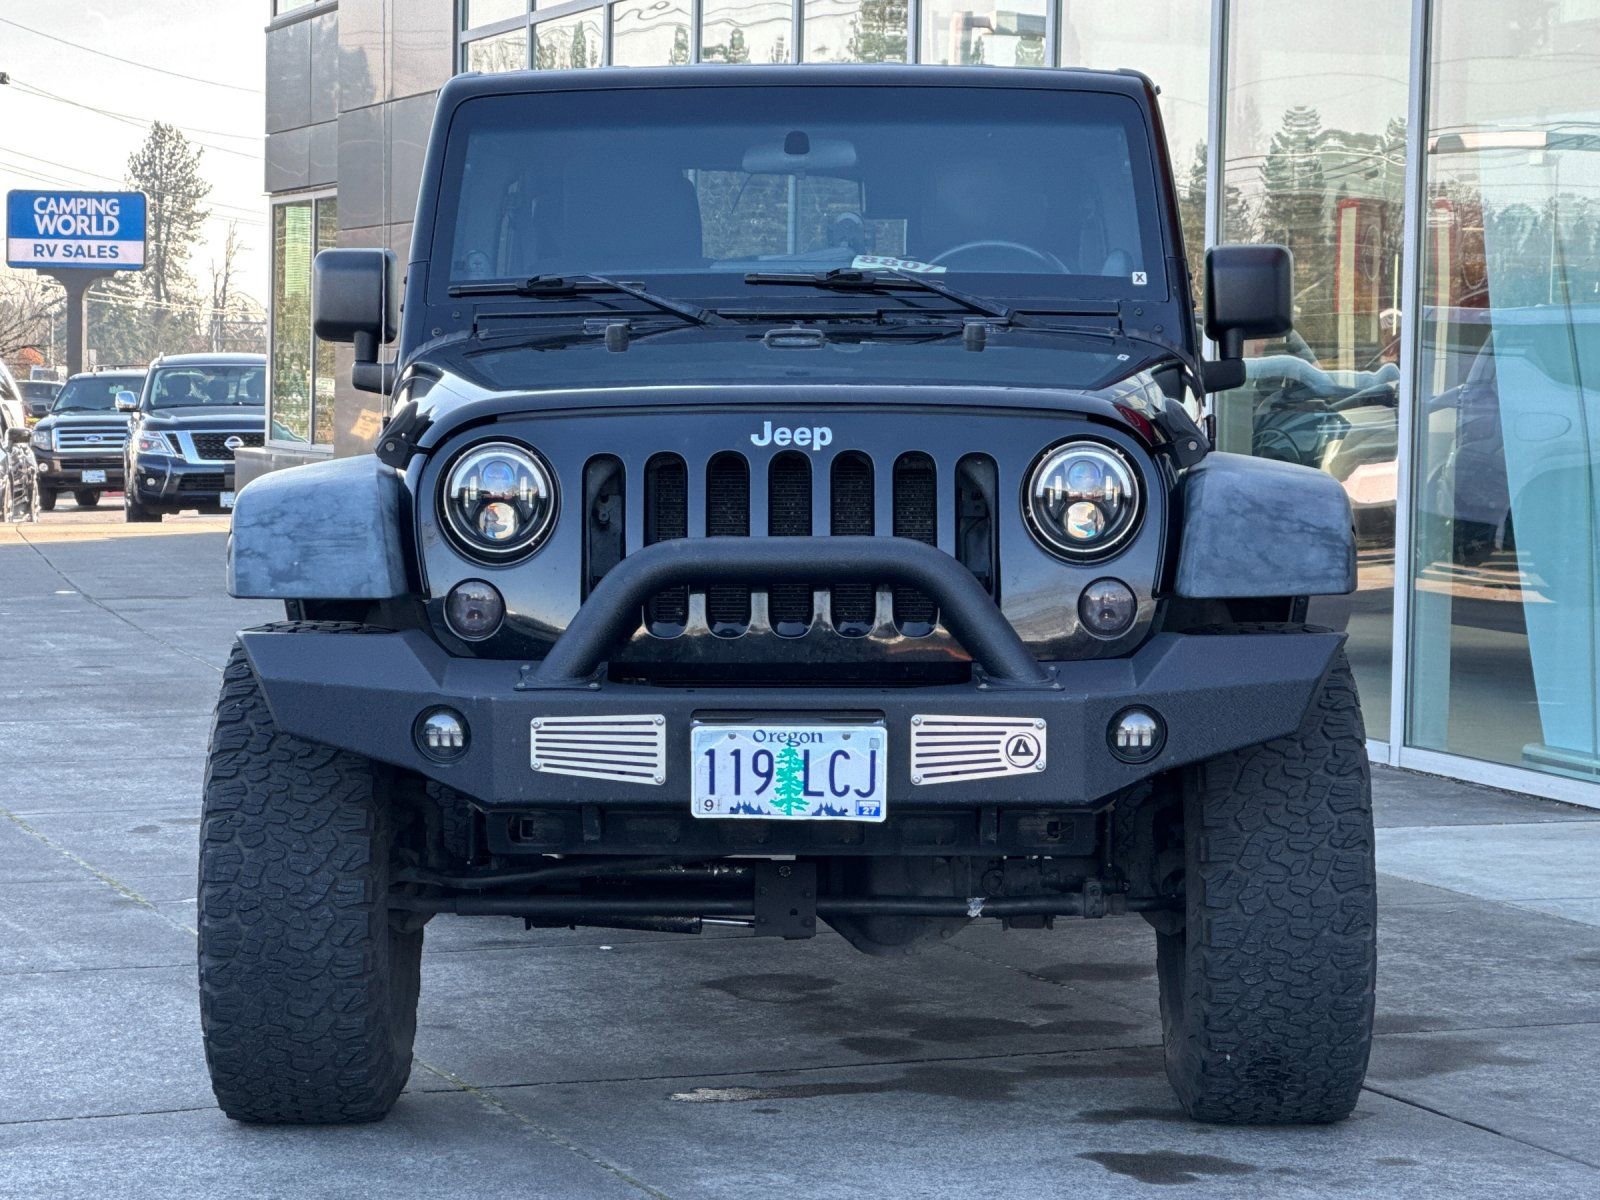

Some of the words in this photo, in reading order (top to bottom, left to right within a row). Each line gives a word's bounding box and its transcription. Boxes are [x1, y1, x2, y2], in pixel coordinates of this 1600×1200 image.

[33, 197, 120, 216] CAMPING
[34, 215, 120, 236] WORLD
[33, 244, 58, 257] RV
[62, 244, 119, 259] SALES
[750, 420, 833, 451] Jeep
[752, 729, 825, 748] Oregon
[704, 748, 775, 796] 119
[803, 748, 877, 799] LCJ
[703, 799, 715, 812] 9
[862, 806, 877, 816] 27
